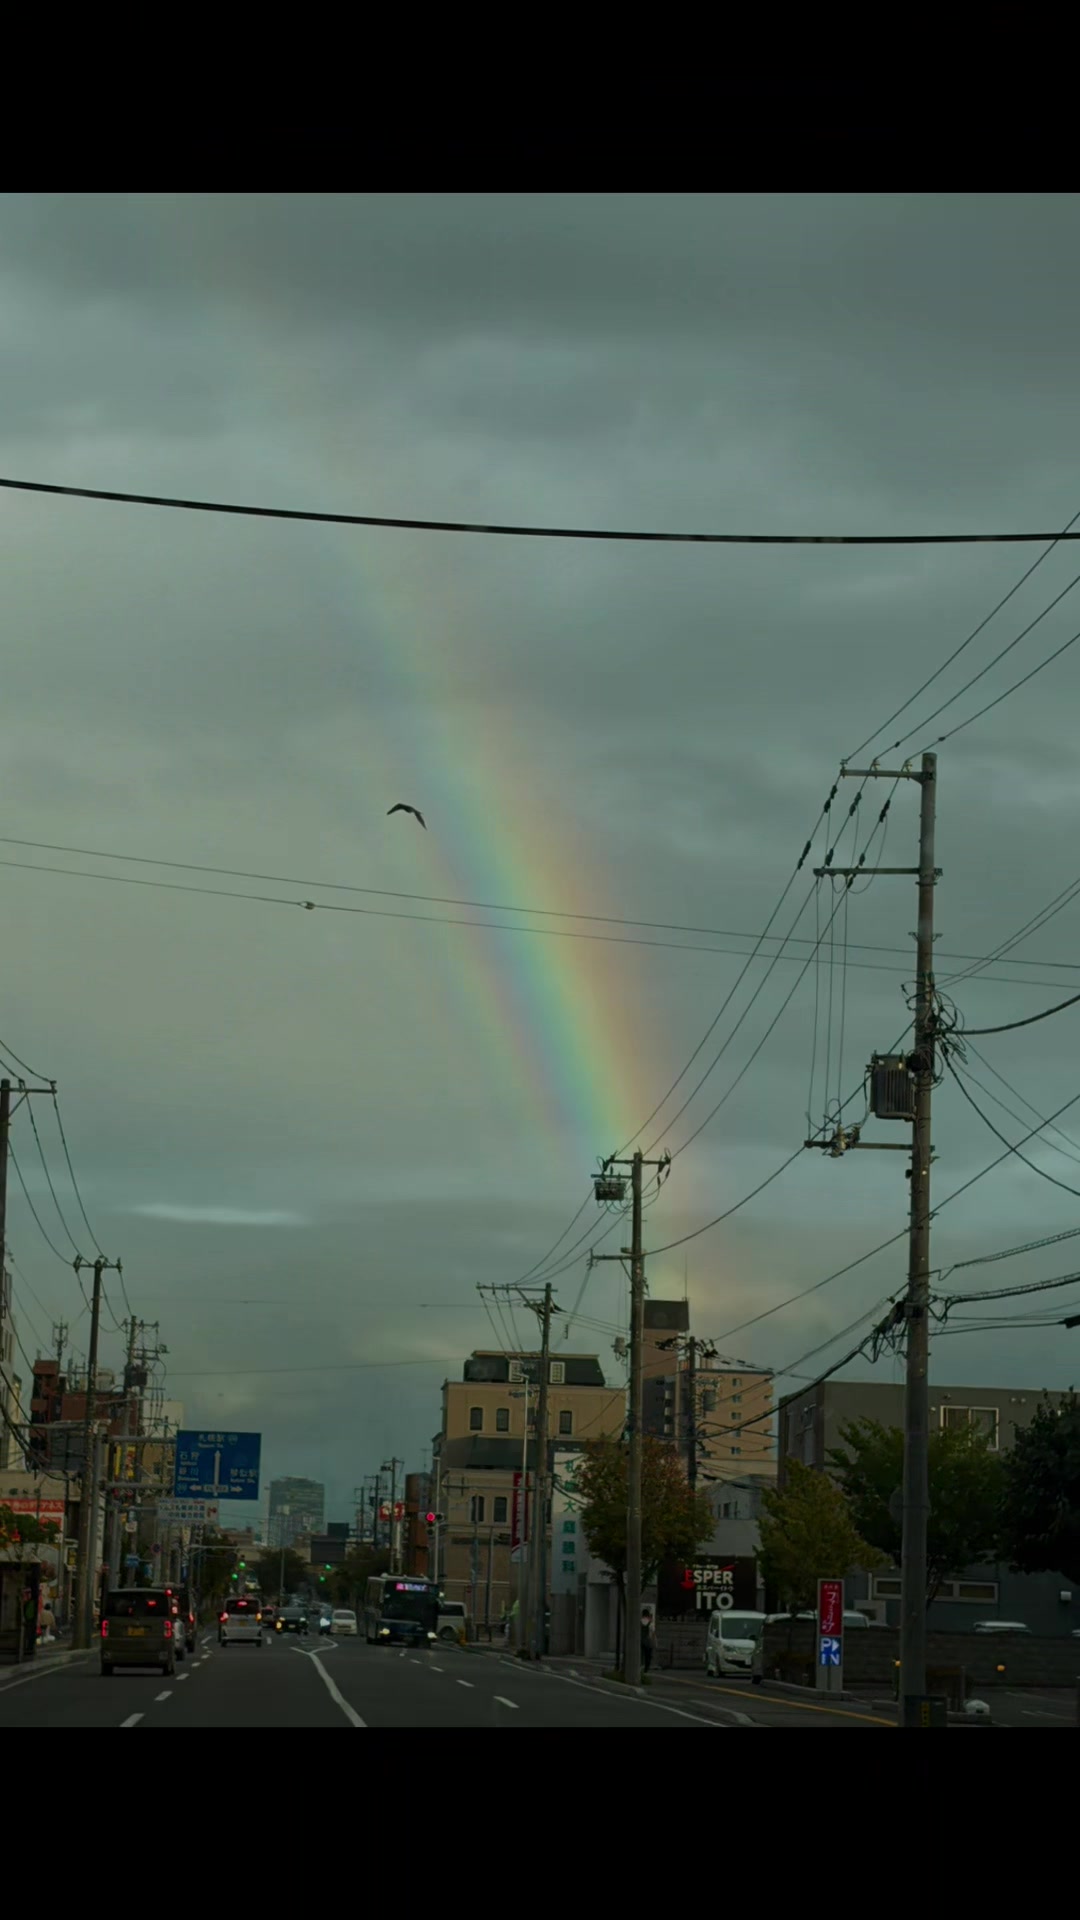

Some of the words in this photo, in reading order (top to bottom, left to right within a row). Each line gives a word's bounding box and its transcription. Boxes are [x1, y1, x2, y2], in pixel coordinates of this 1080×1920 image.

[685, 1569, 734, 1585] ESPER
[696, 1592, 734, 1610] ITO
[820, 1638, 832, 1652] P
[821, 1653, 840, 1666] IN
